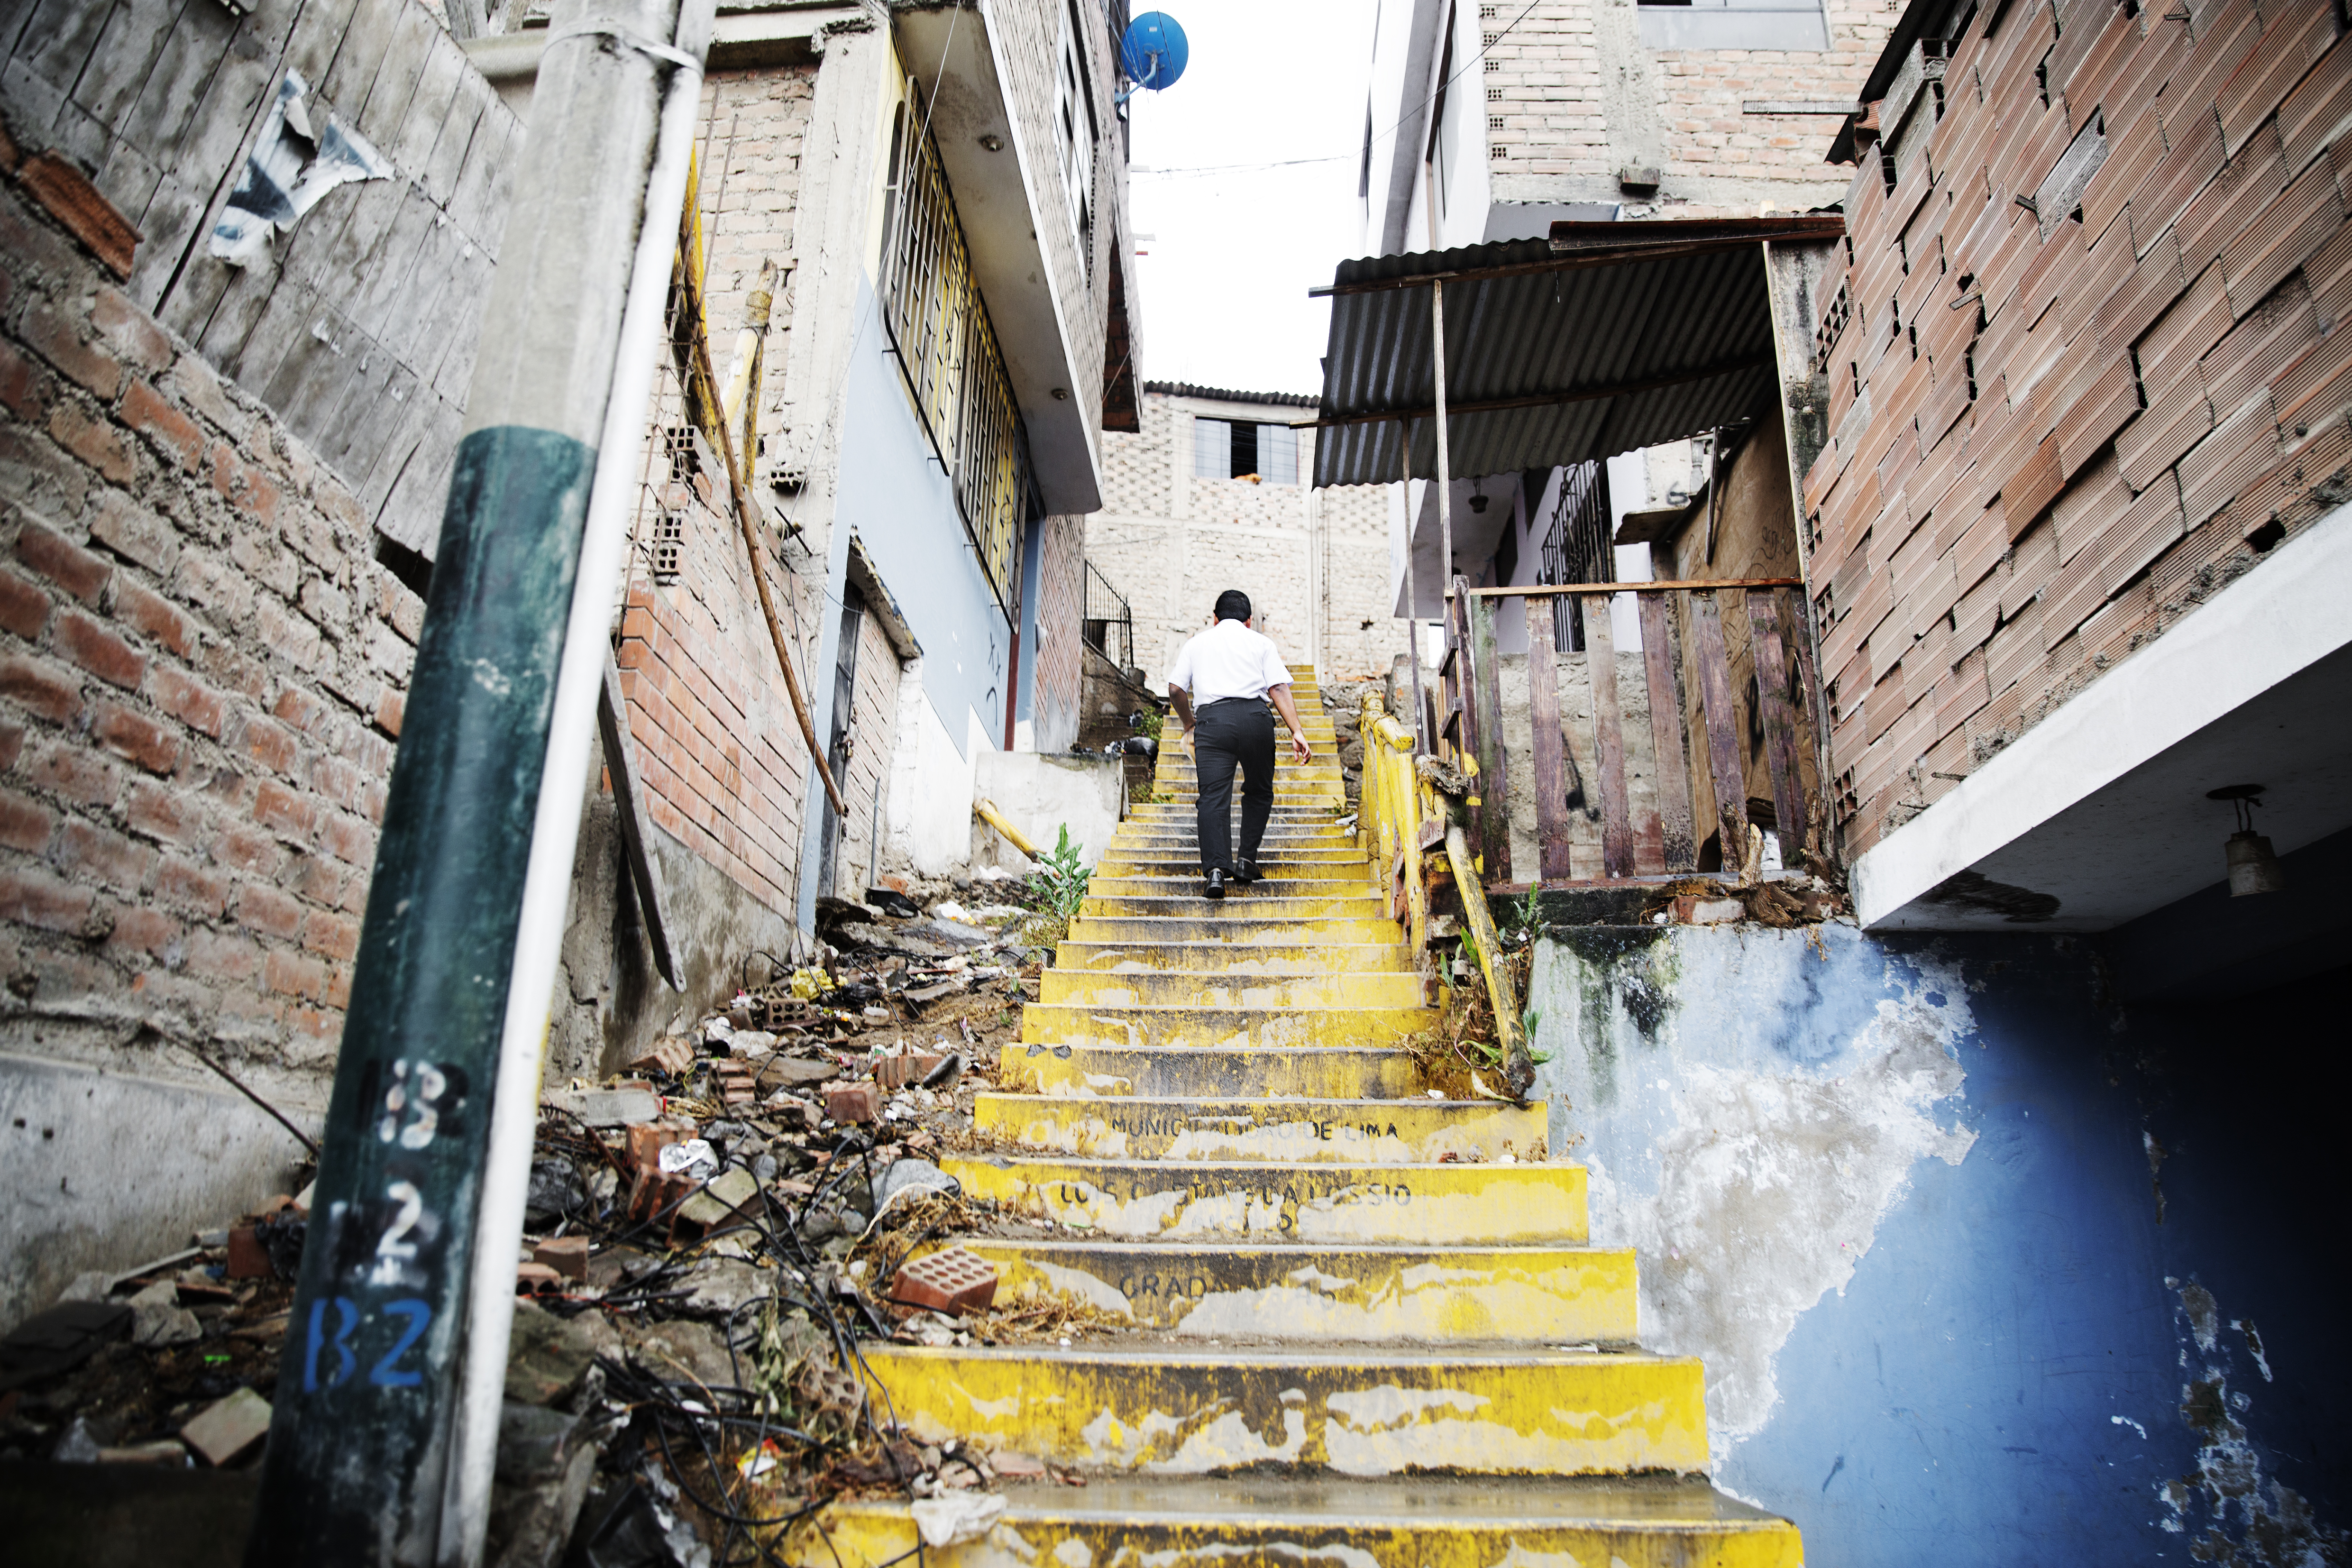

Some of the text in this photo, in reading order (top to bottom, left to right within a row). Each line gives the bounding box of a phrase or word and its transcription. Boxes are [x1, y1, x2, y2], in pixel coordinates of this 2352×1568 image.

[1303, 1121, 1333, 1140] DE
[1345, 1122, 1398, 1141] LIMA
[304, 1295, 431, 1393] B2
